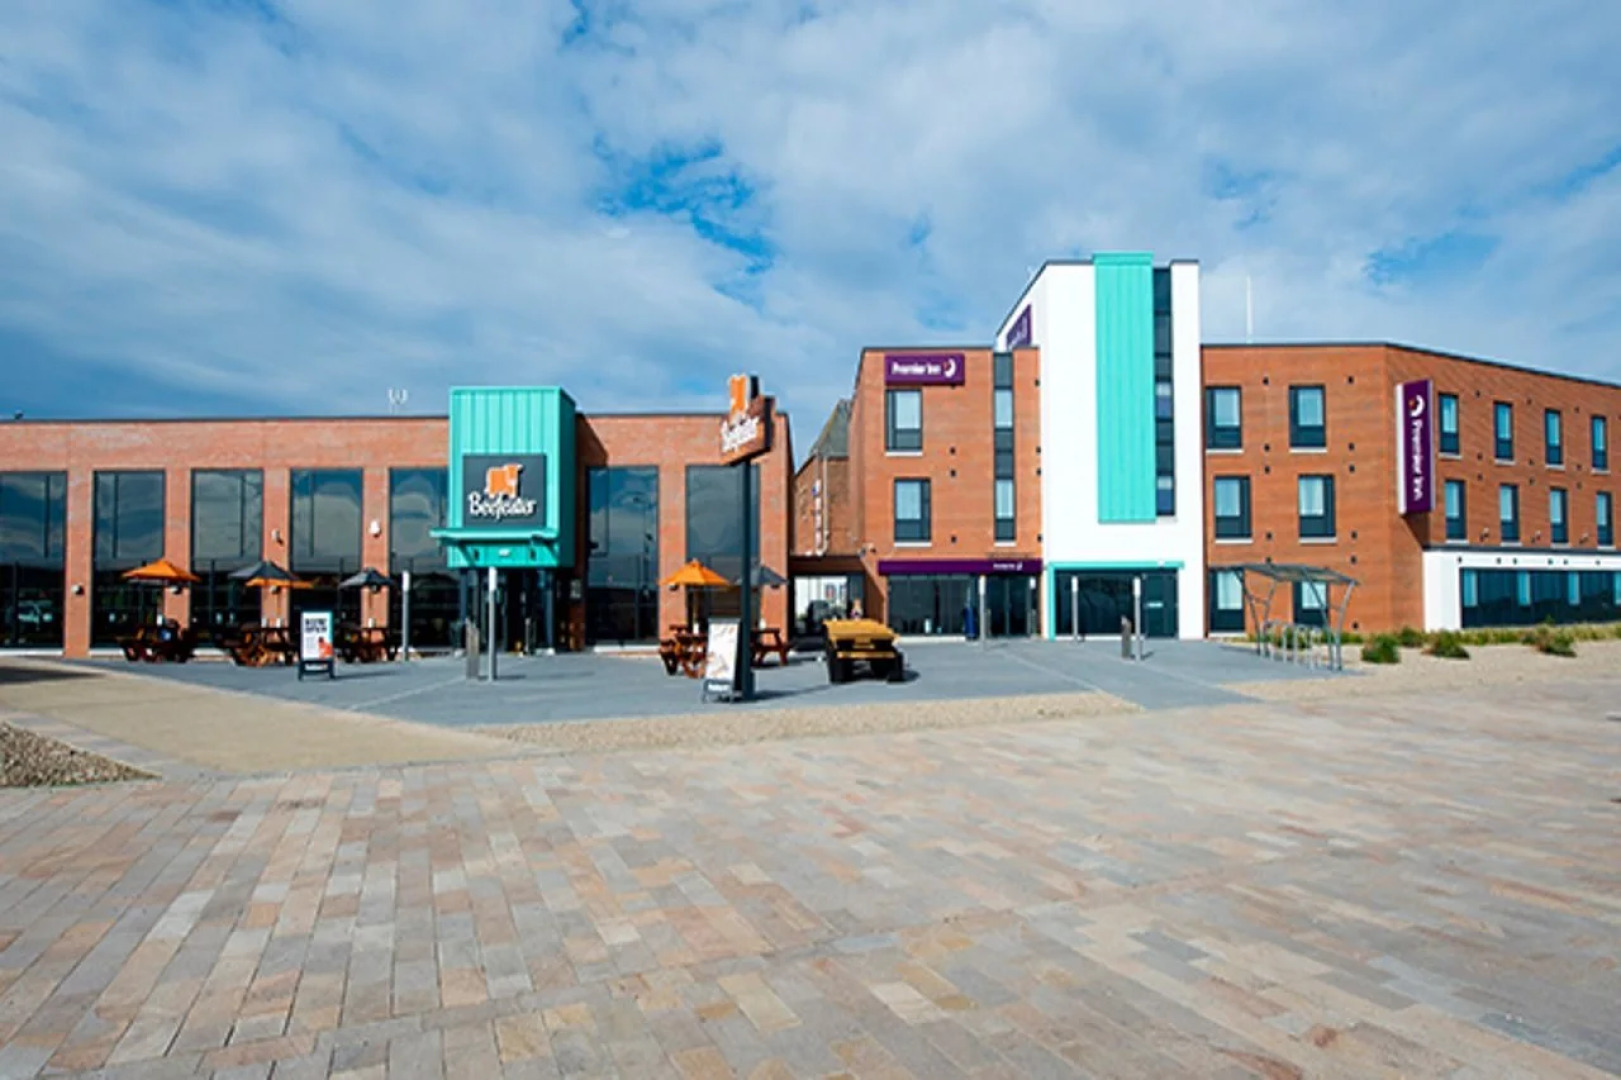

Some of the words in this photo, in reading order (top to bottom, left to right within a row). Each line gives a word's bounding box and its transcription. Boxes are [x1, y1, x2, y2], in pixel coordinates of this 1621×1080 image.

[1411, 419, 1423, 473] Premier
[1413, 475, 1424, 501] Inn
[467, 491, 537, 519] Beefeater
